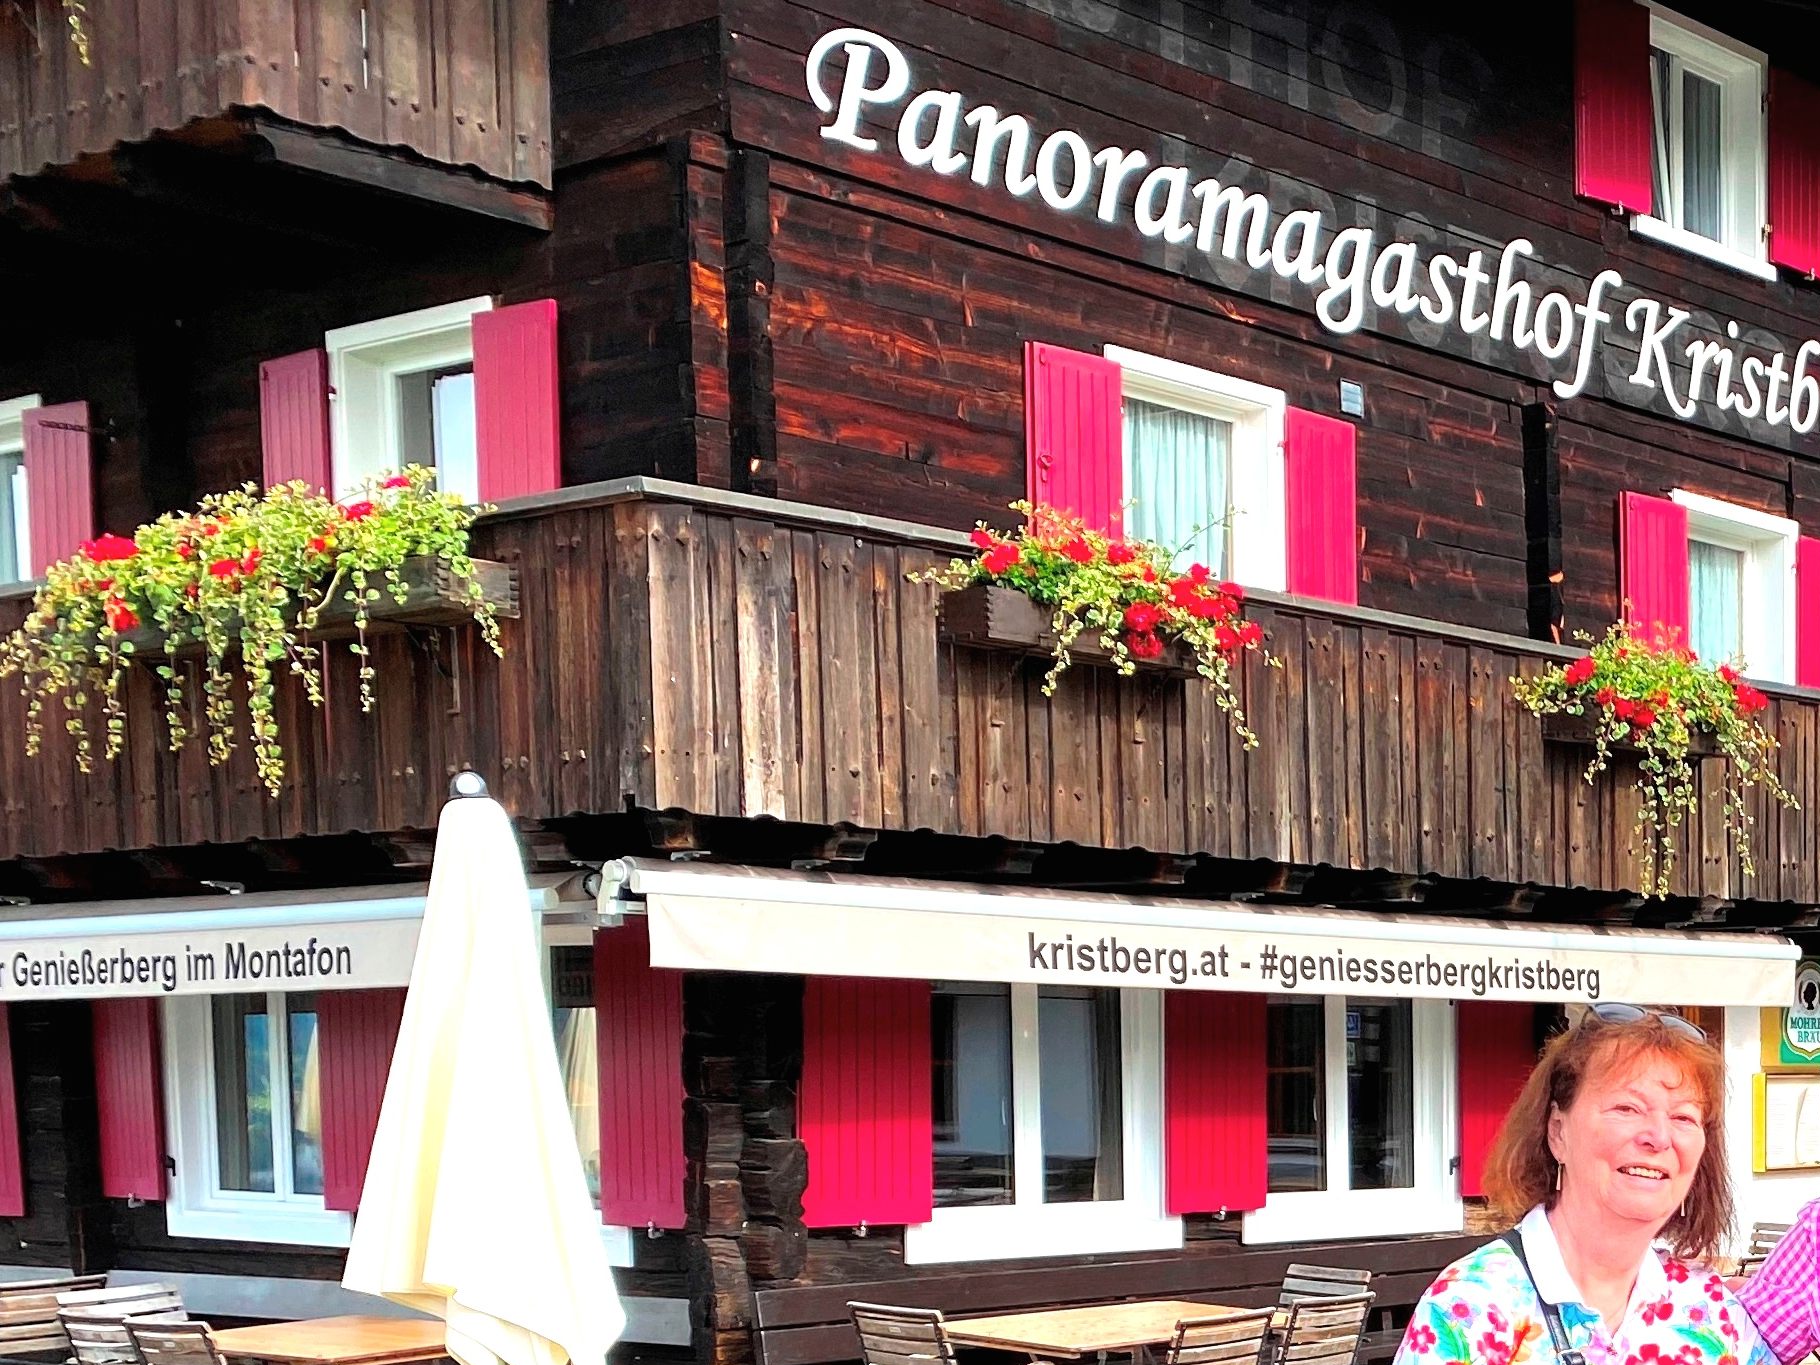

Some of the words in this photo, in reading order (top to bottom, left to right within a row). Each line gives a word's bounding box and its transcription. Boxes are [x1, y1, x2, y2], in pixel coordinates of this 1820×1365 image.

[805, 27, 1623, 400] Panoramagasthof
[12, 948, 178, 992] Genießerberg
[185, 945, 216, 982] im
[225, 938, 353, 980] Montafon
[1027, 933, 1230, 984] kristberg.at
[1260, 943, 1602, 999] #geniesserbergkristberg
